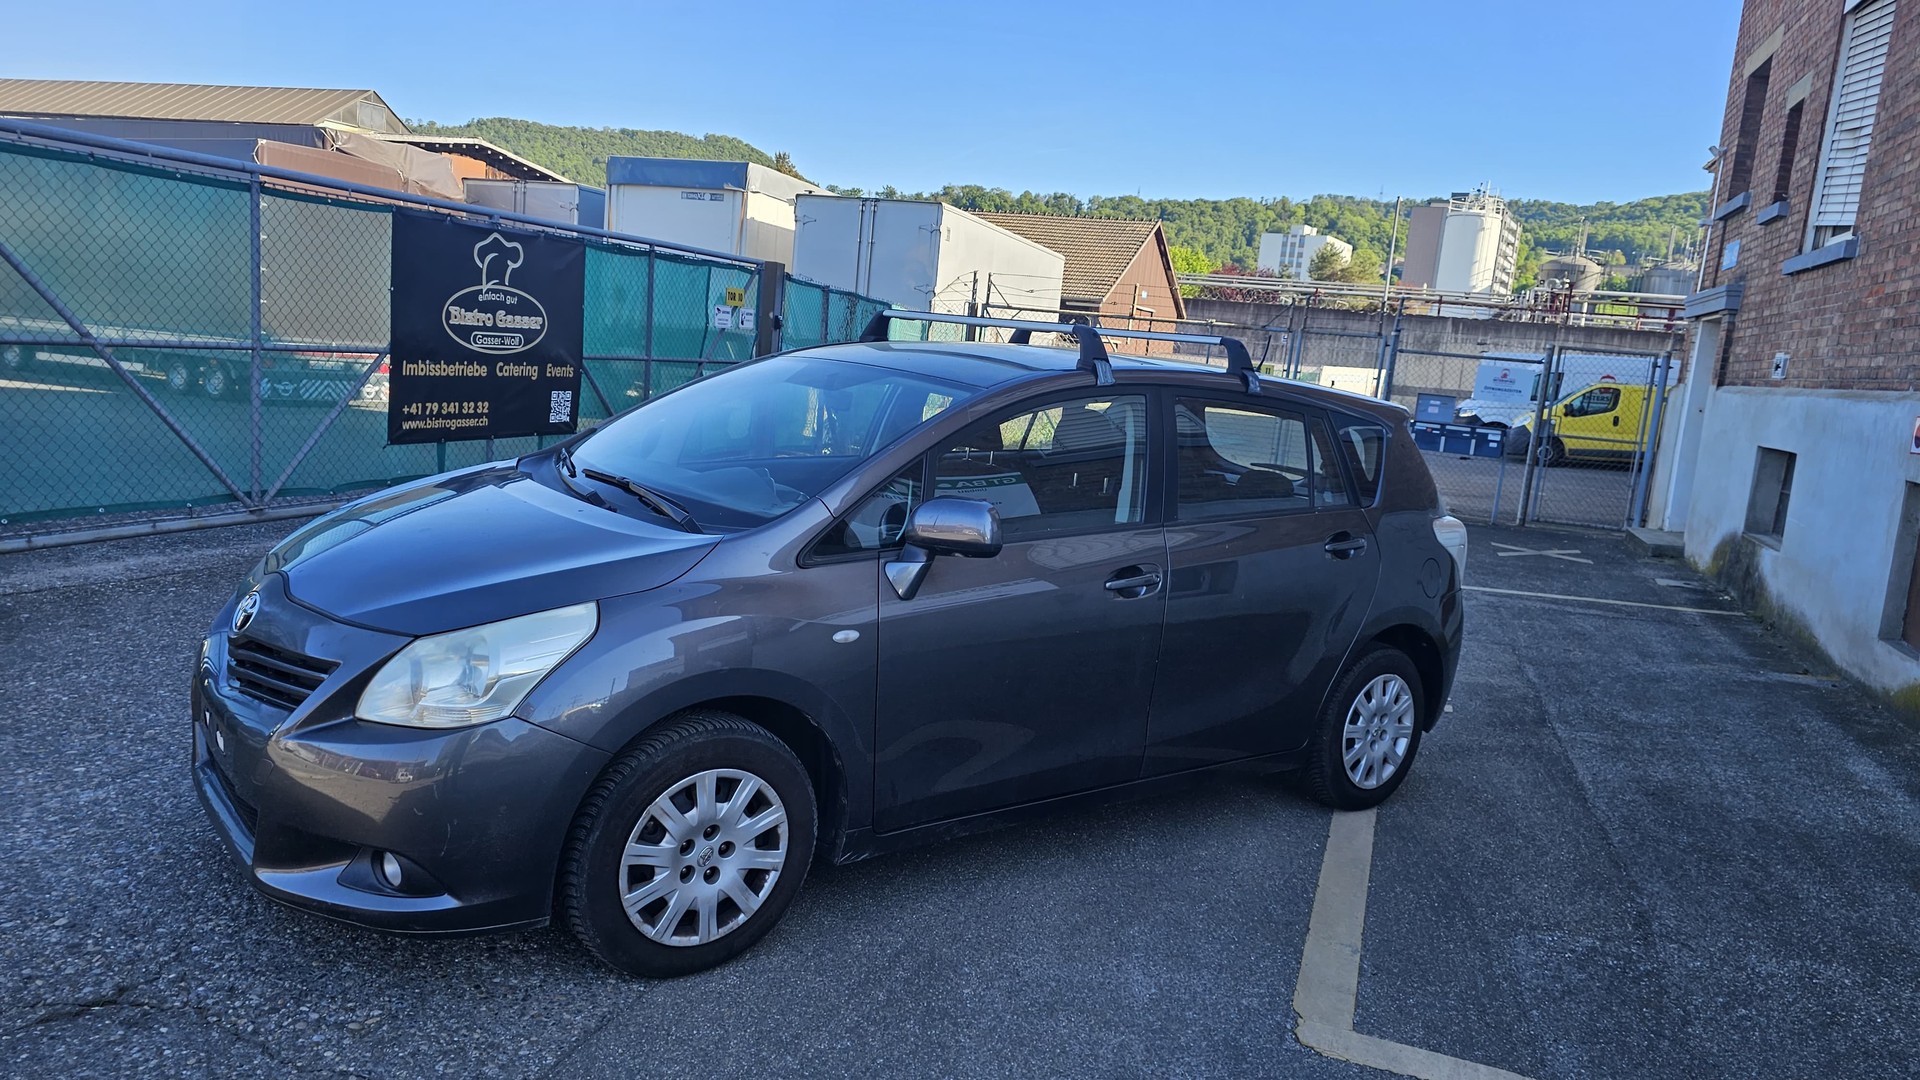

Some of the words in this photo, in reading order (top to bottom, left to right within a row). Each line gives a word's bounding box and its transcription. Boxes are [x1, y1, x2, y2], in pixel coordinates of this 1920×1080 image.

[478, 291, 505, 302] einfach
[506, 295, 518, 304] gut
[727, 291, 736, 301] TOR
[448, 306, 493, 326] Bistro
[495, 310, 543, 329] Gasser
[475, 334, 520, 346] Gasser-Wolf
[402, 360, 487, 376] Imbissbetriebe
[496, 361, 539, 380] Catering
[546, 363, 574, 378] Events
[402, 402, 422, 415] +41
[425, 402, 439, 415] 79
[441, 401, 459, 415] 341
[462, 401, 474, 414] 32
[476, 401, 489, 414] 32
[401, 415, 489, 430] www.bistrogasser.ch
